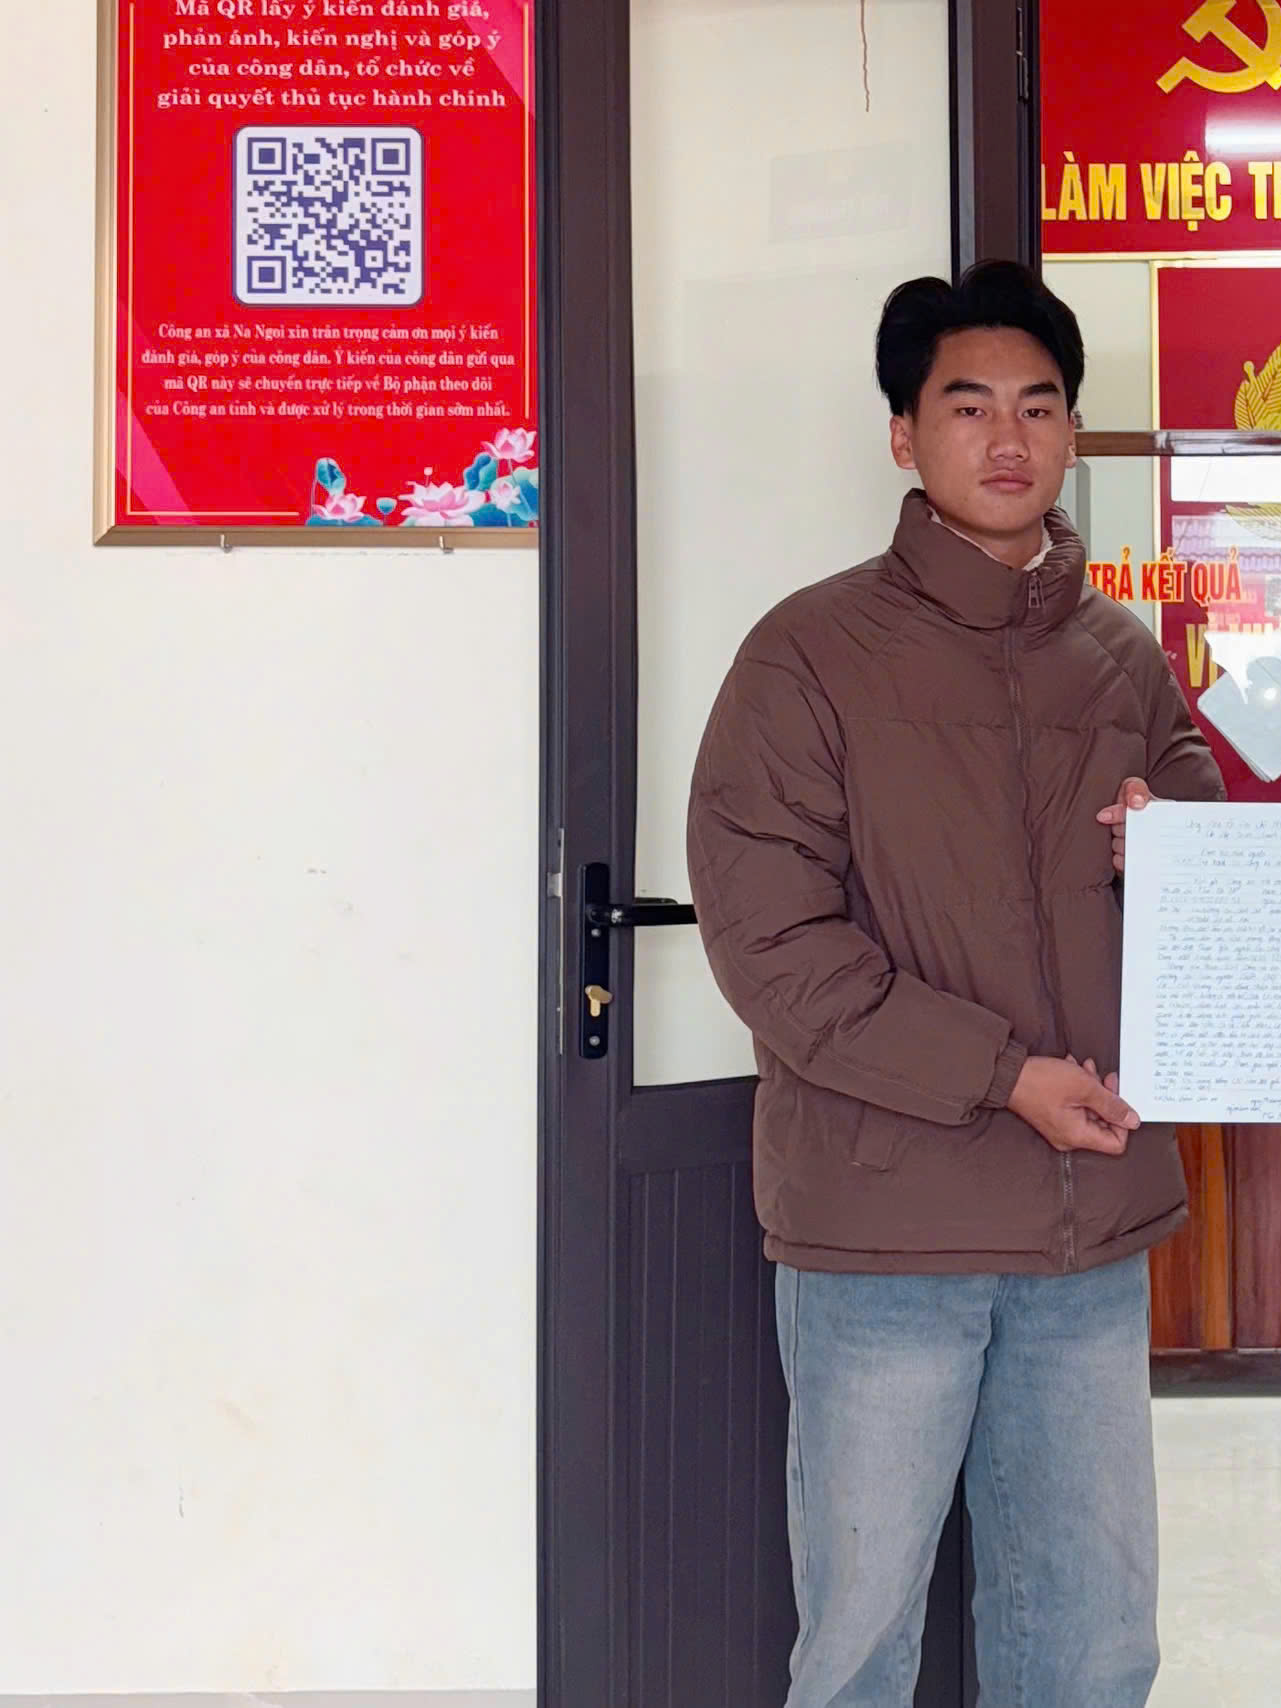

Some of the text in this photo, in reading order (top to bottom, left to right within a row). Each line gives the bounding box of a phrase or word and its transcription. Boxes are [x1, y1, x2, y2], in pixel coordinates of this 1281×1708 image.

[217, 0, 254, 19] QR
[163, 26, 502, 50] phản ánh, kiến nghị và góp ý
[188, 56, 475, 79] của công dân, tổ chức về
[157, 87, 507, 110] giải quyết thủ tục hành chính
[1041, 151, 1127, 221] LÀM
[1140, 150, 1233, 232] VIỆC
[1087, 545, 1243, 607] TRẢ KẾT QUẢ
